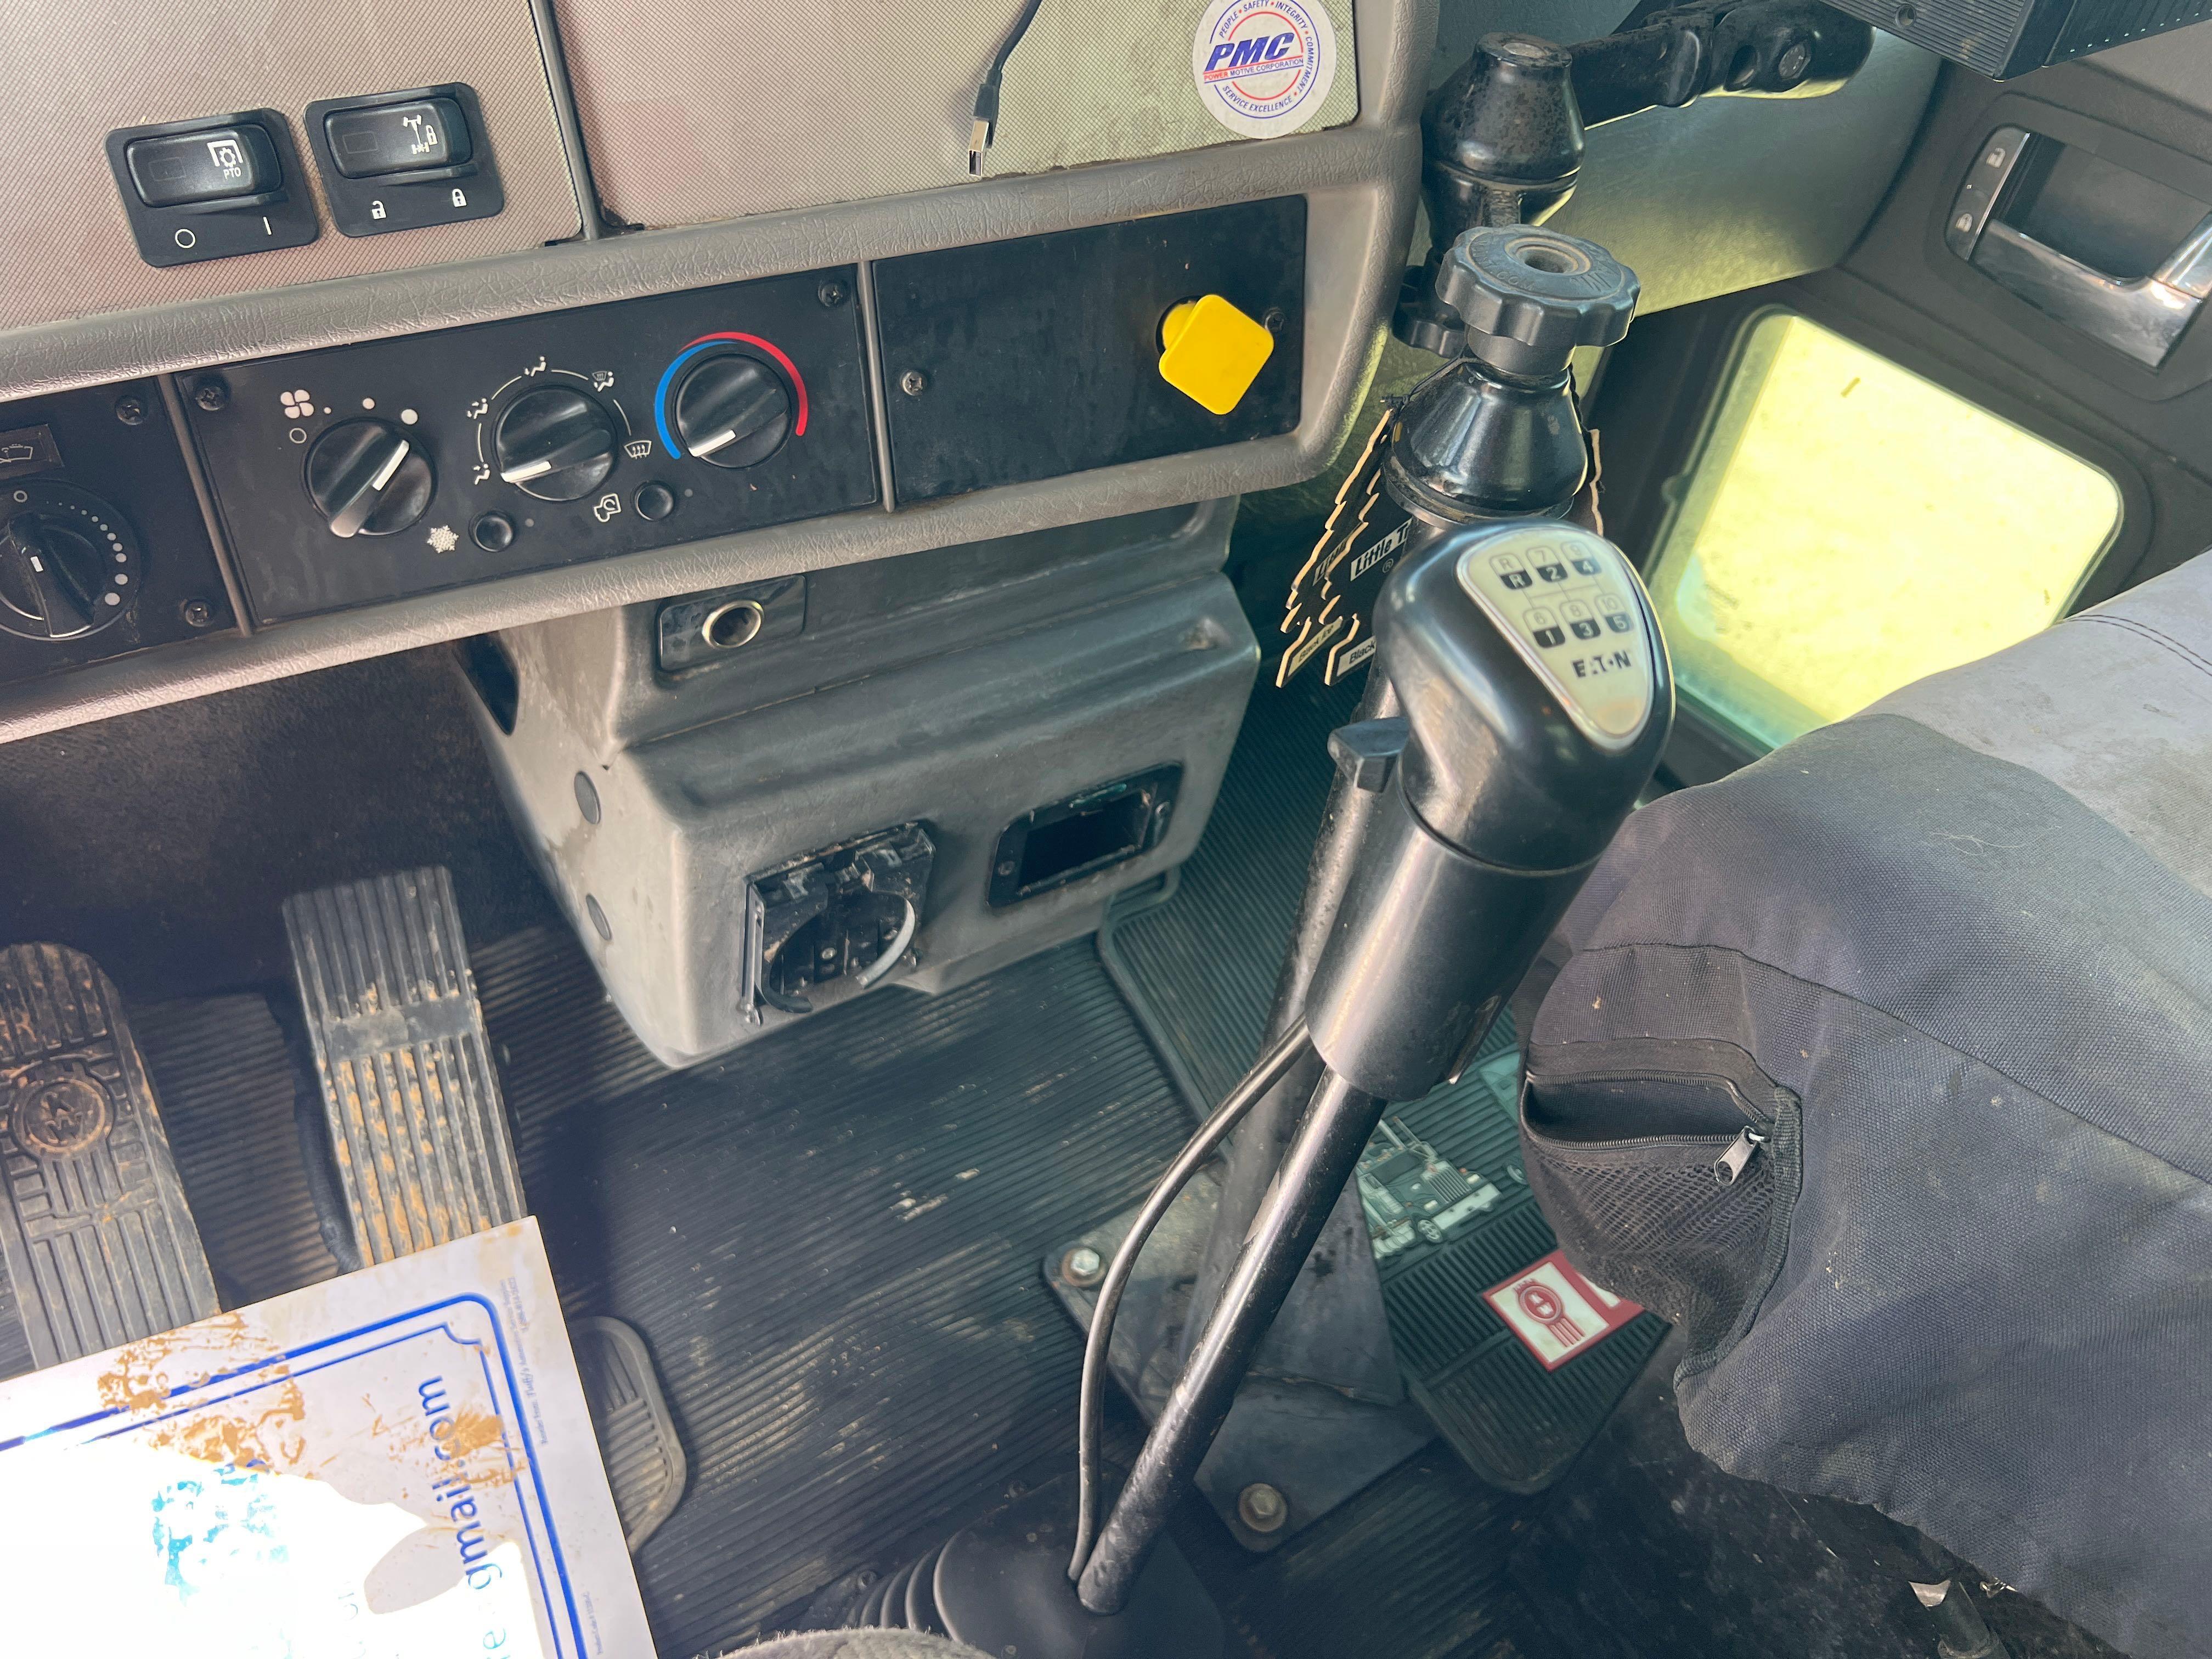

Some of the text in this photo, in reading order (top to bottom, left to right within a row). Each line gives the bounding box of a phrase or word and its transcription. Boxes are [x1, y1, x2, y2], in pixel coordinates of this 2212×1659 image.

[1204, 32, 1295, 71] PMC
[1219, 0, 1314, 93] PEOPLE SAFETY INTEGRITY COMMITMENT
[1204, 58, 1304, 82] POWER MOTIVE CORPORATION
[1222, 86, 1294, 112] SERVICE EXCELLENCE
[223, 166, 242, 180] PTO
[1355, 539, 1392, 577] Little
[1535, 550, 1547, 563] 7
[1509, 560, 1594, 589] R 2 4
[1545, 615, 1627, 646] 1 3 5
[1348, 640, 1376, 664] Black
